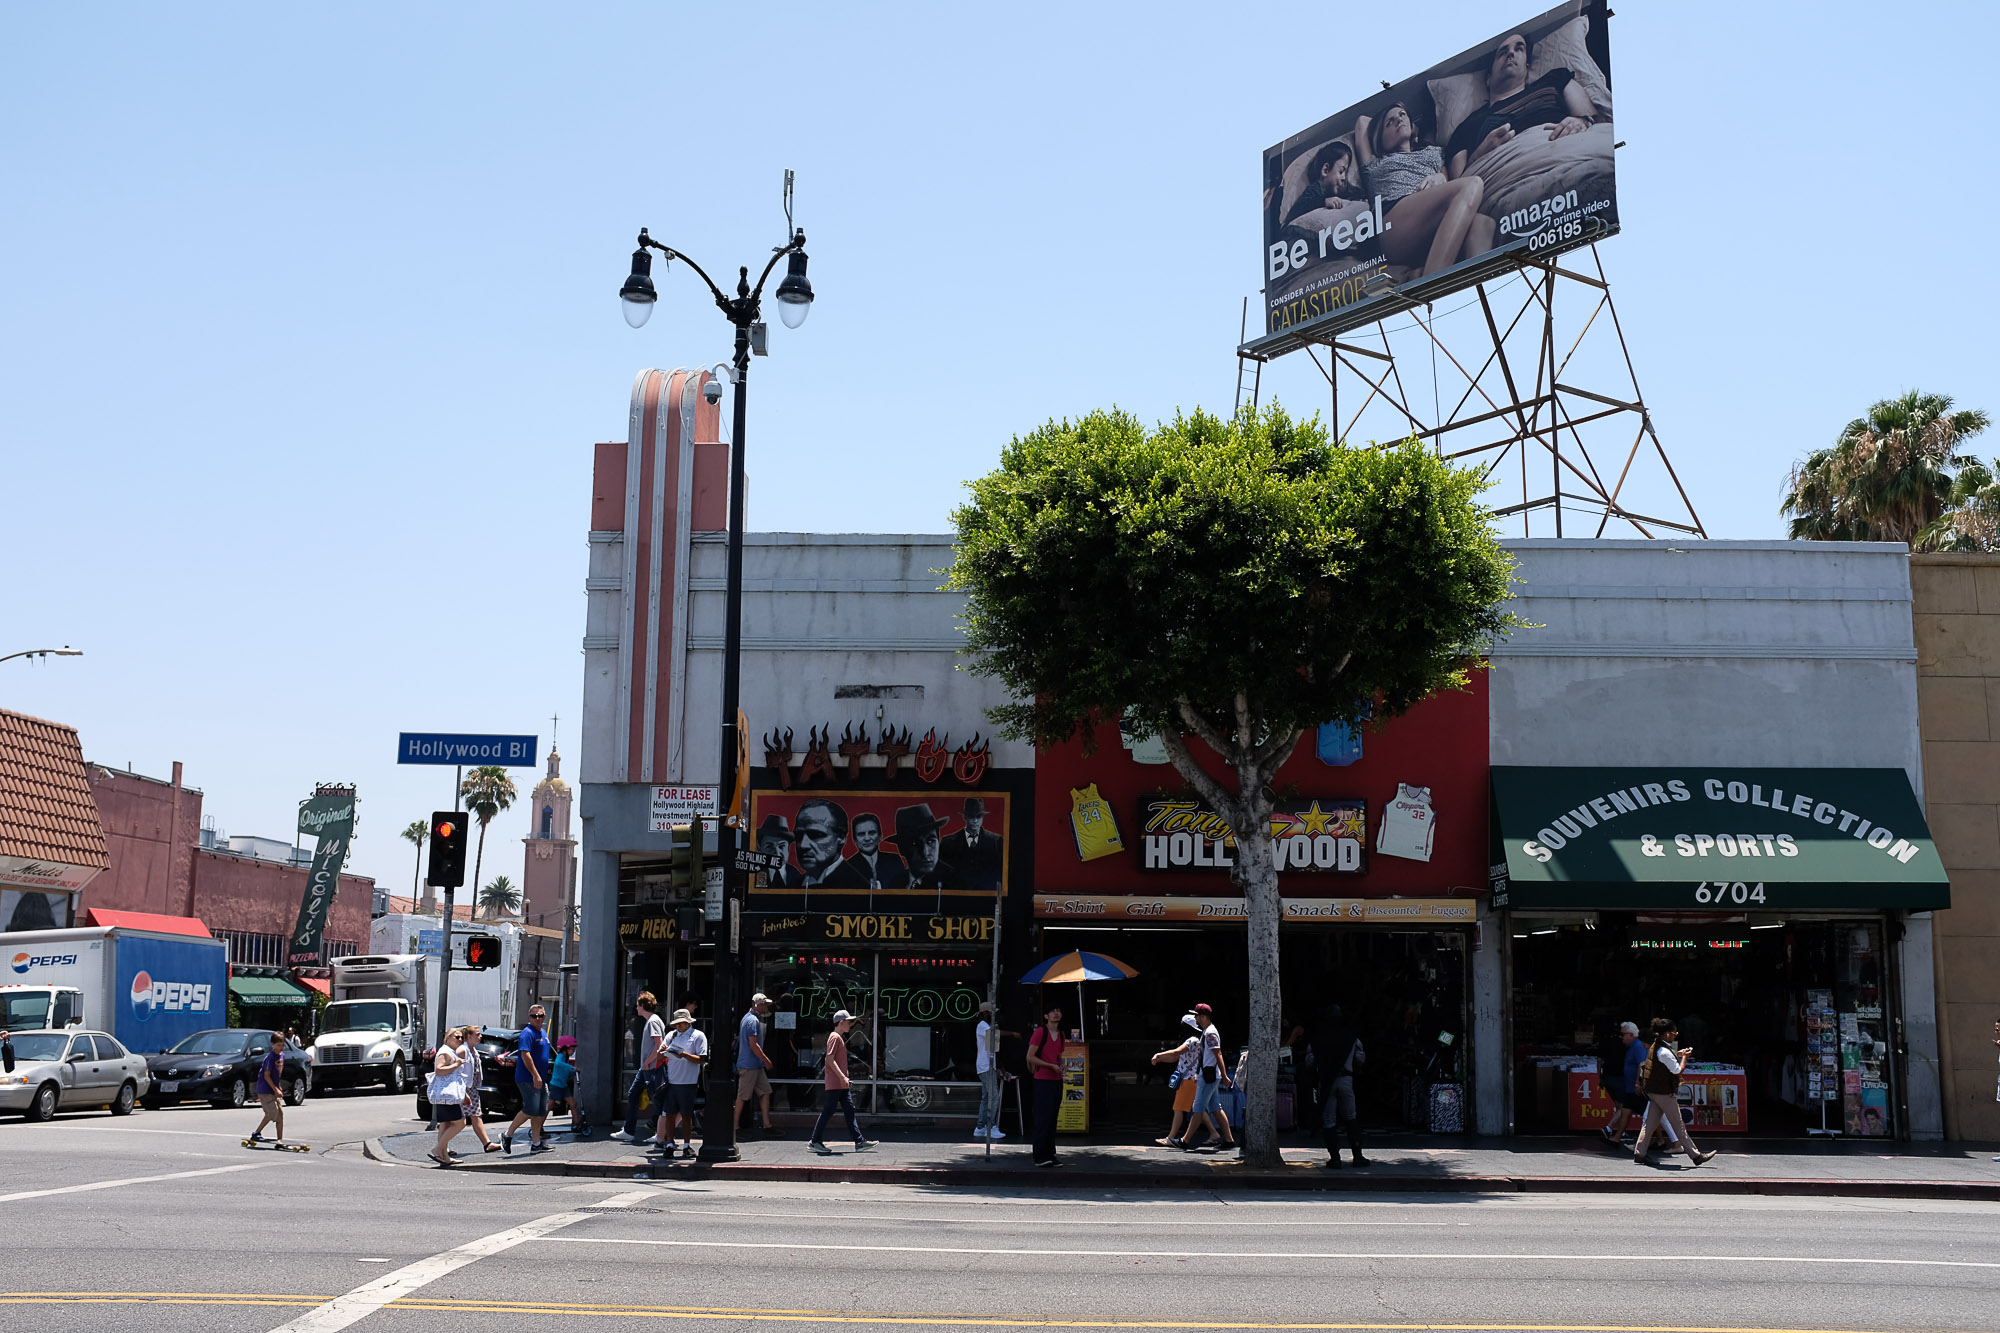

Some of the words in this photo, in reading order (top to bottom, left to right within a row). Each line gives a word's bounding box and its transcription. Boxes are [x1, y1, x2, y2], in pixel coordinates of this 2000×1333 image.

[1499, 189, 1578, 235] amazon
[1553, 210, 1581, 227] prime
[1582, 199, 1610, 215] video
[1269, 240, 1309, 281] Be
[1318, 194, 1392, 260] real.
[1529, 219, 1582, 251] 006195
[1270, 288, 1304, 308] CONSIDER
[1305, 282, 1316, 294] AN
[1317, 269, 1350, 289] AMAZON
[1351, 254, 1388, 275] ORIGINAL
[1271, 265, 1388, 334] CATASTROP
[408, 739, 502, 761] Hollywood
[509, 742, 527, 758] Bl
[763, 720, 992, 791] TATTOO
[657, 788, 678, 800] FOR
[680, 789, 711, 800] LEASE
[653, 800, 686, 811] Hollywood
[687, 801, 714, 811] Highland
[1078, 800, 1100, 812] LAKERS
[1081, 807, 1102, 825] 24
[1395, 801, 1426, 811] Clippers
[1412, 810, 1426, 820] 32
[300, 804, 352, 832] Original
[1145, 801, 1233, 841] Tony
[1522, 779, 1691, 863] SOUVENIRS
[1703, 778, 1920, 864] COLLECTION
[1145, 832, 1361, 871] HOLLWOOD
[1640, 834, 1666, 857] &
[1674, 833, 1799, 857] SPORTS
[735, 861, 748, 870] 600
[745, 851, 767, 865] PALMAS
[707, 871, 723, 882] LAPD
[1695, 881, 1766, 904] 6704
[1044, 899, 1106, 914] T-Shirt
[1126, 902, 1167, 916] Gift
[1287, 901, 1341, 917] Snack
[1348, 904, 1361, 918] &
[1367, 905, 1422, 915] Discounted
[1430, 905, 1470, 918] Luggage
[620, 923, 639, 935] BODY
[641, 918, 676, 939] PIERC
[825, 914, 913, 939] SMOKE
[927, 916, 996, 940] SHOP
[29, 954, 78, 967] PEPSI
[290, 952, 319, 963] PIZZERIA
[151, 981, 212, 1013] PEPSI
[793, 986, 981, 1022] TATTOO
[1577, 1079, 1592, 1099] 4
[1580, 1103, 1610, 1118] For
